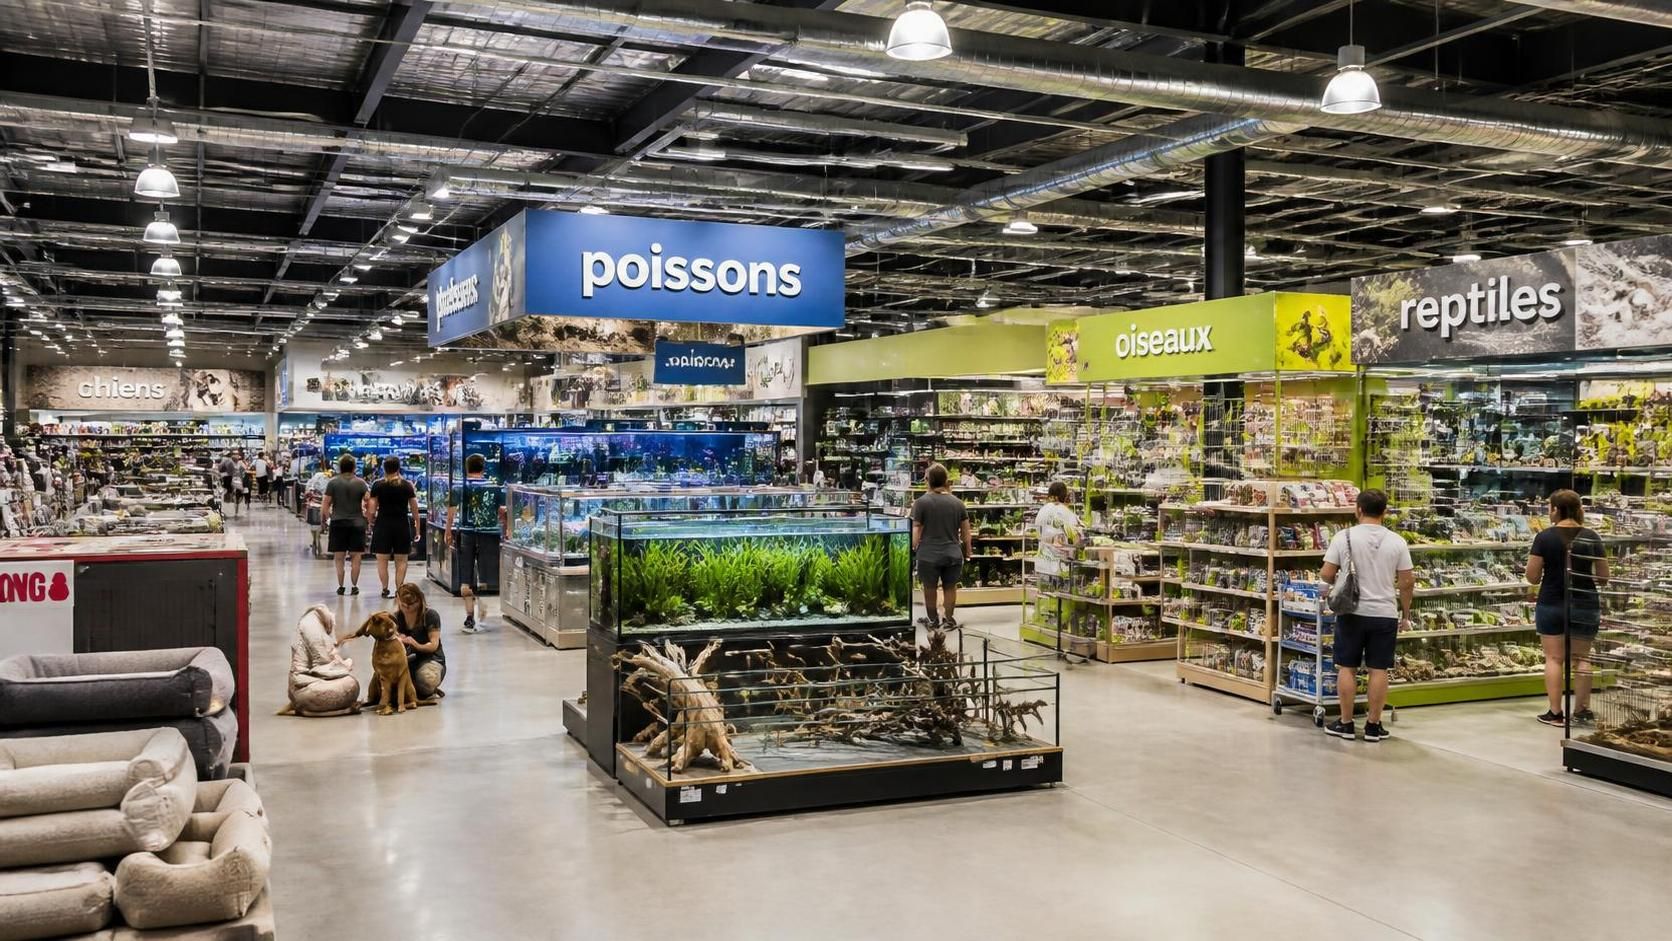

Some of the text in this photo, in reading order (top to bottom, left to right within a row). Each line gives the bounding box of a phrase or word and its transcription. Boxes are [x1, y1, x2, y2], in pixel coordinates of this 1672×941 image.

[582, 243, 802, 298] poissons
[1400, 275, 1564, 339] reptiles
[1115, 323, 1214, 358] oiseaux
[78, 376, 166, 399] chiens
